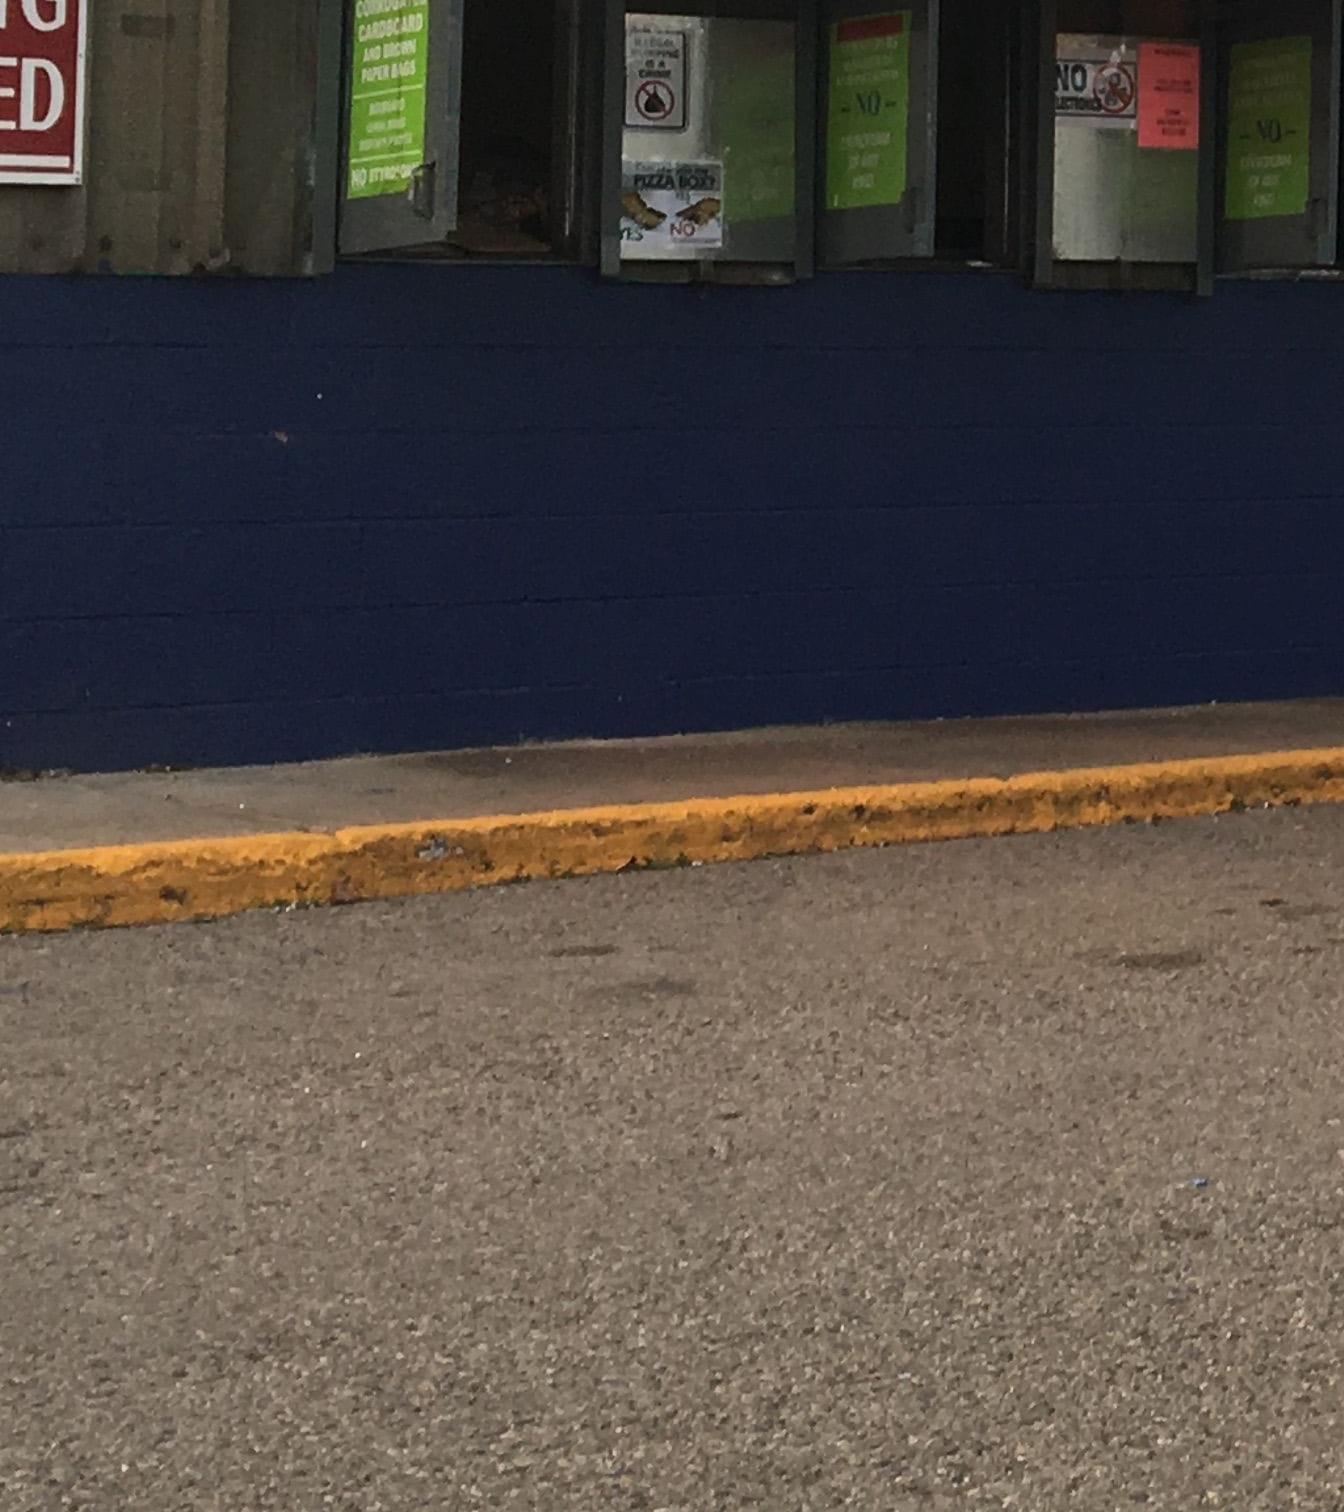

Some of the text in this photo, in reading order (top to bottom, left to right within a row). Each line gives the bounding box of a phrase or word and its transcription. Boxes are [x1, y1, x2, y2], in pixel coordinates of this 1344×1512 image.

[1055, 63, 1087, 92] NO
[634, 173, 675, 190] PIZZA
[670, 222, 696, 237] NO
